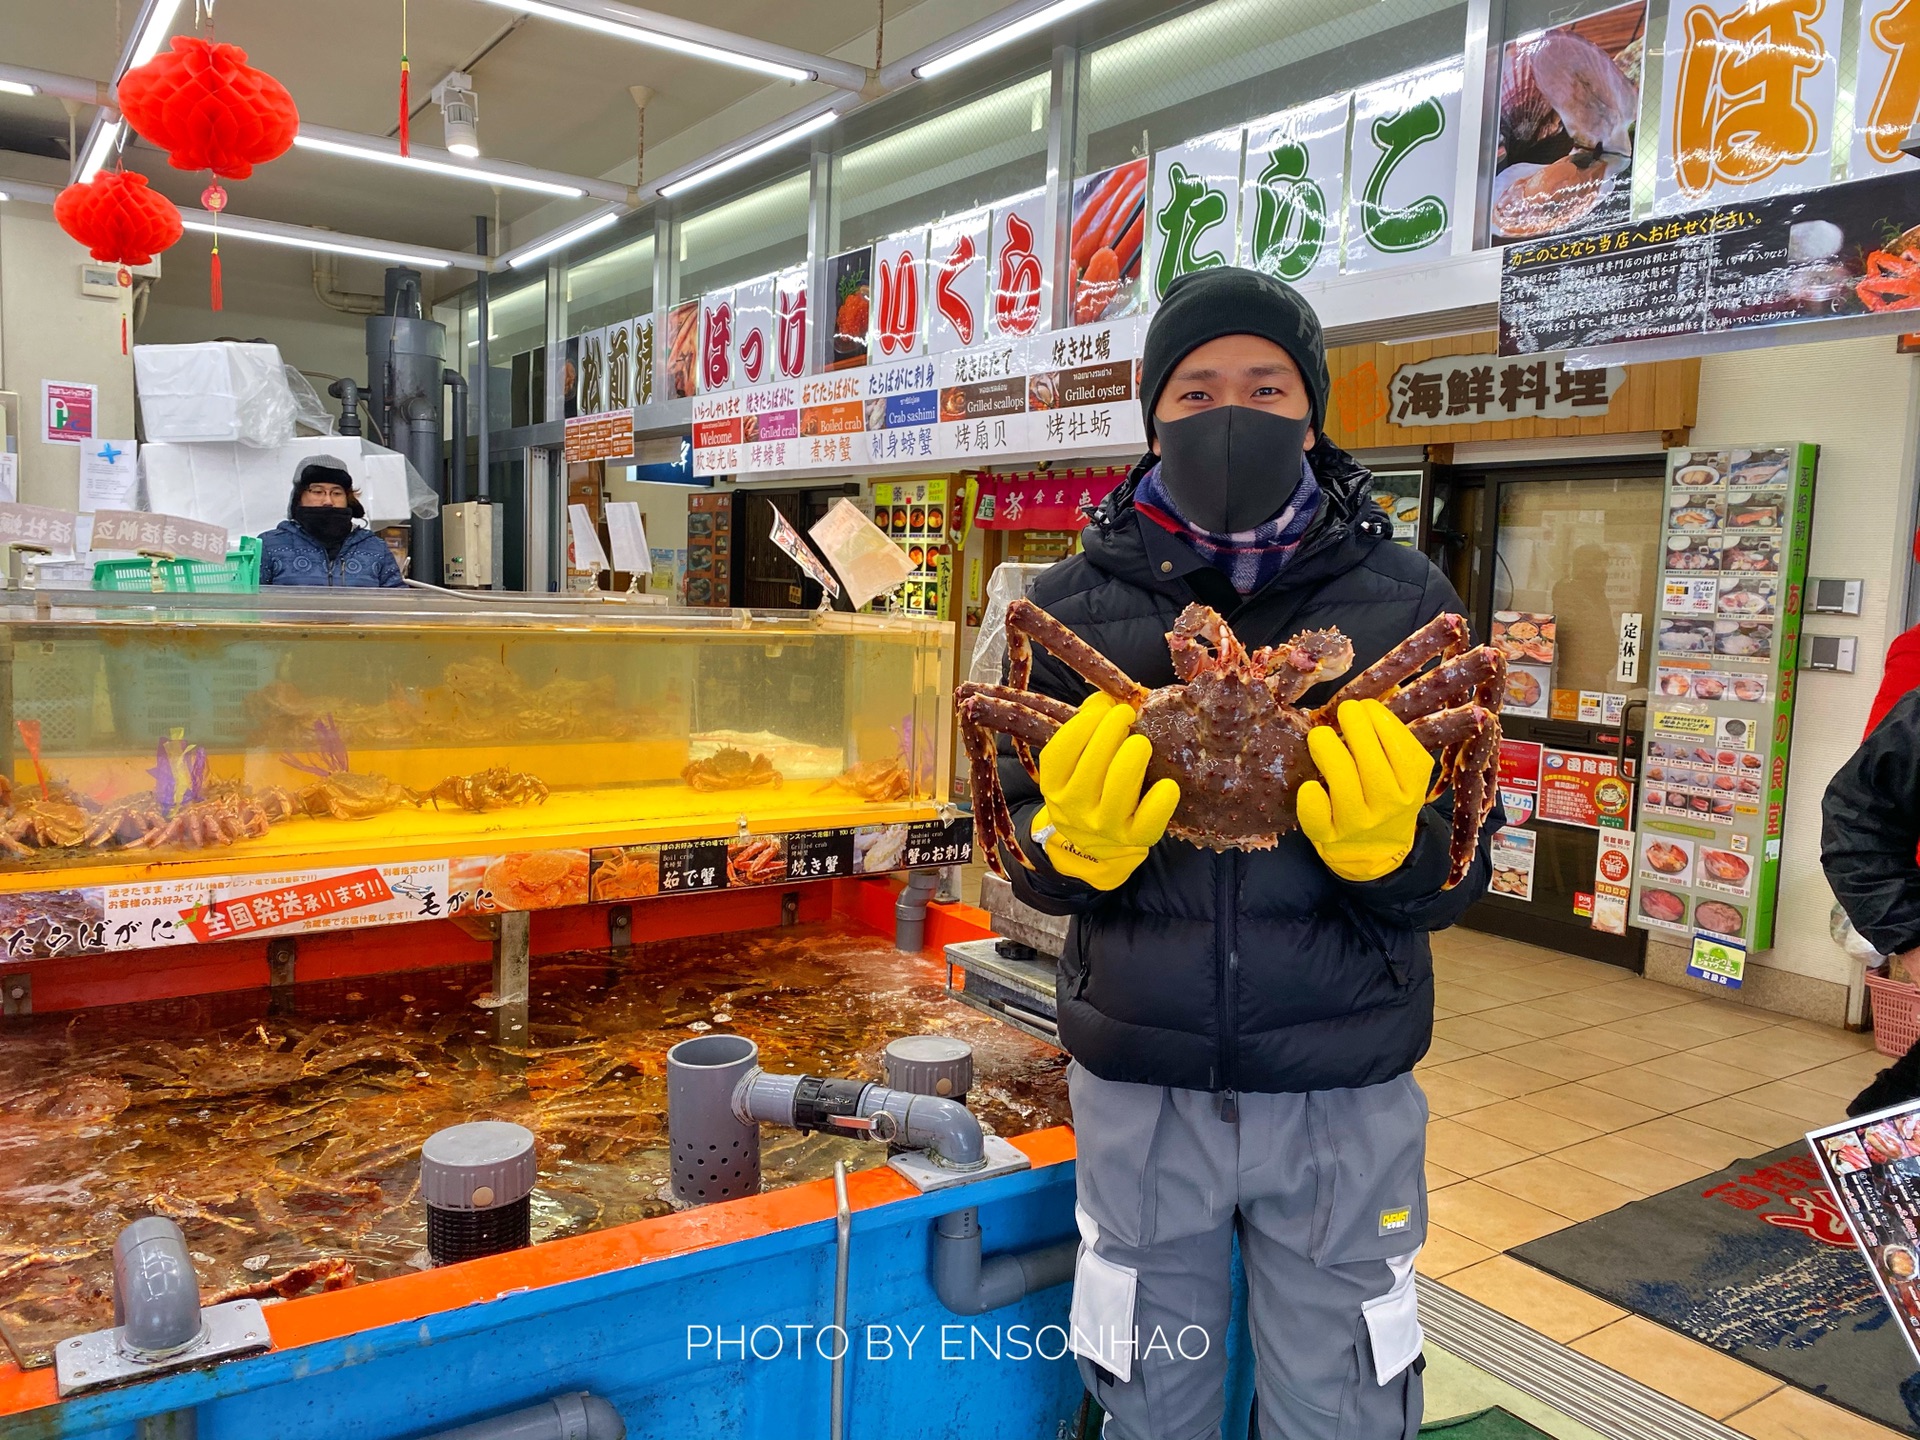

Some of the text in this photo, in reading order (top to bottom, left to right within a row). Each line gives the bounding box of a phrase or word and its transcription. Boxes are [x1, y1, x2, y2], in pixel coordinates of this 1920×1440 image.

[1512, 210, 1762, 266] カニのことなら当店へお任せください。
[878, 212, 1042, 355] いくら
[703, 280, 808, 391] ほっけ
[1052, 329, 1111, 367] 焼き牡蠣
[868, 362, 935, 395] たらばがに刺身
[954, 348, 1013, 383] 焼きほたて
[746, 387, 795, 414] 焼きたらばがに
[802, 377, 860, 404] 茹でたらばがに
[967, 394, 1025, 414] Grilled scallops
[1065, 383, 1127, 402] Grilled oyster
[1397, 361, 1610, 420] 海鮮料理
[694, 396, 740, 420] いらっしゃいませ
[888, 406, 936, 425] Crab sashimi
[760, 422, 797, 439] Grilled crab
[820, 415, 862, 432] Boiled crab
[954, 419, 1007, 452] 烤扇贝
[1046, 409, 1112, 445] 烤牡蛎
[700, 429, 732, 446] Welcome
[810, 435, 852, 464] 煮螃蟹
[871, 427, 933, 459] 刺身螃蟹
[695, 449, 738, 472] 欢迎光临
[750, 441, 786, 468] 烤螃蟹
[1003, 491, 1024, 521] 茶
[1621, 623, 1638, 677] 定休日
[791, 855, 839, 876] 焼き蟹
[907, 844, 972, 865] 蟹のお刺身
[663, 867, 715, 889] 茹で蟹
[202, 878, 385, 937] 全国発送承ります!!
[418, 889, 495, 916] 毛がに
[302, 911, 413, 930] 冷蔵便でお届け致します!!
[6, 917, 175, 957] たらばがに
